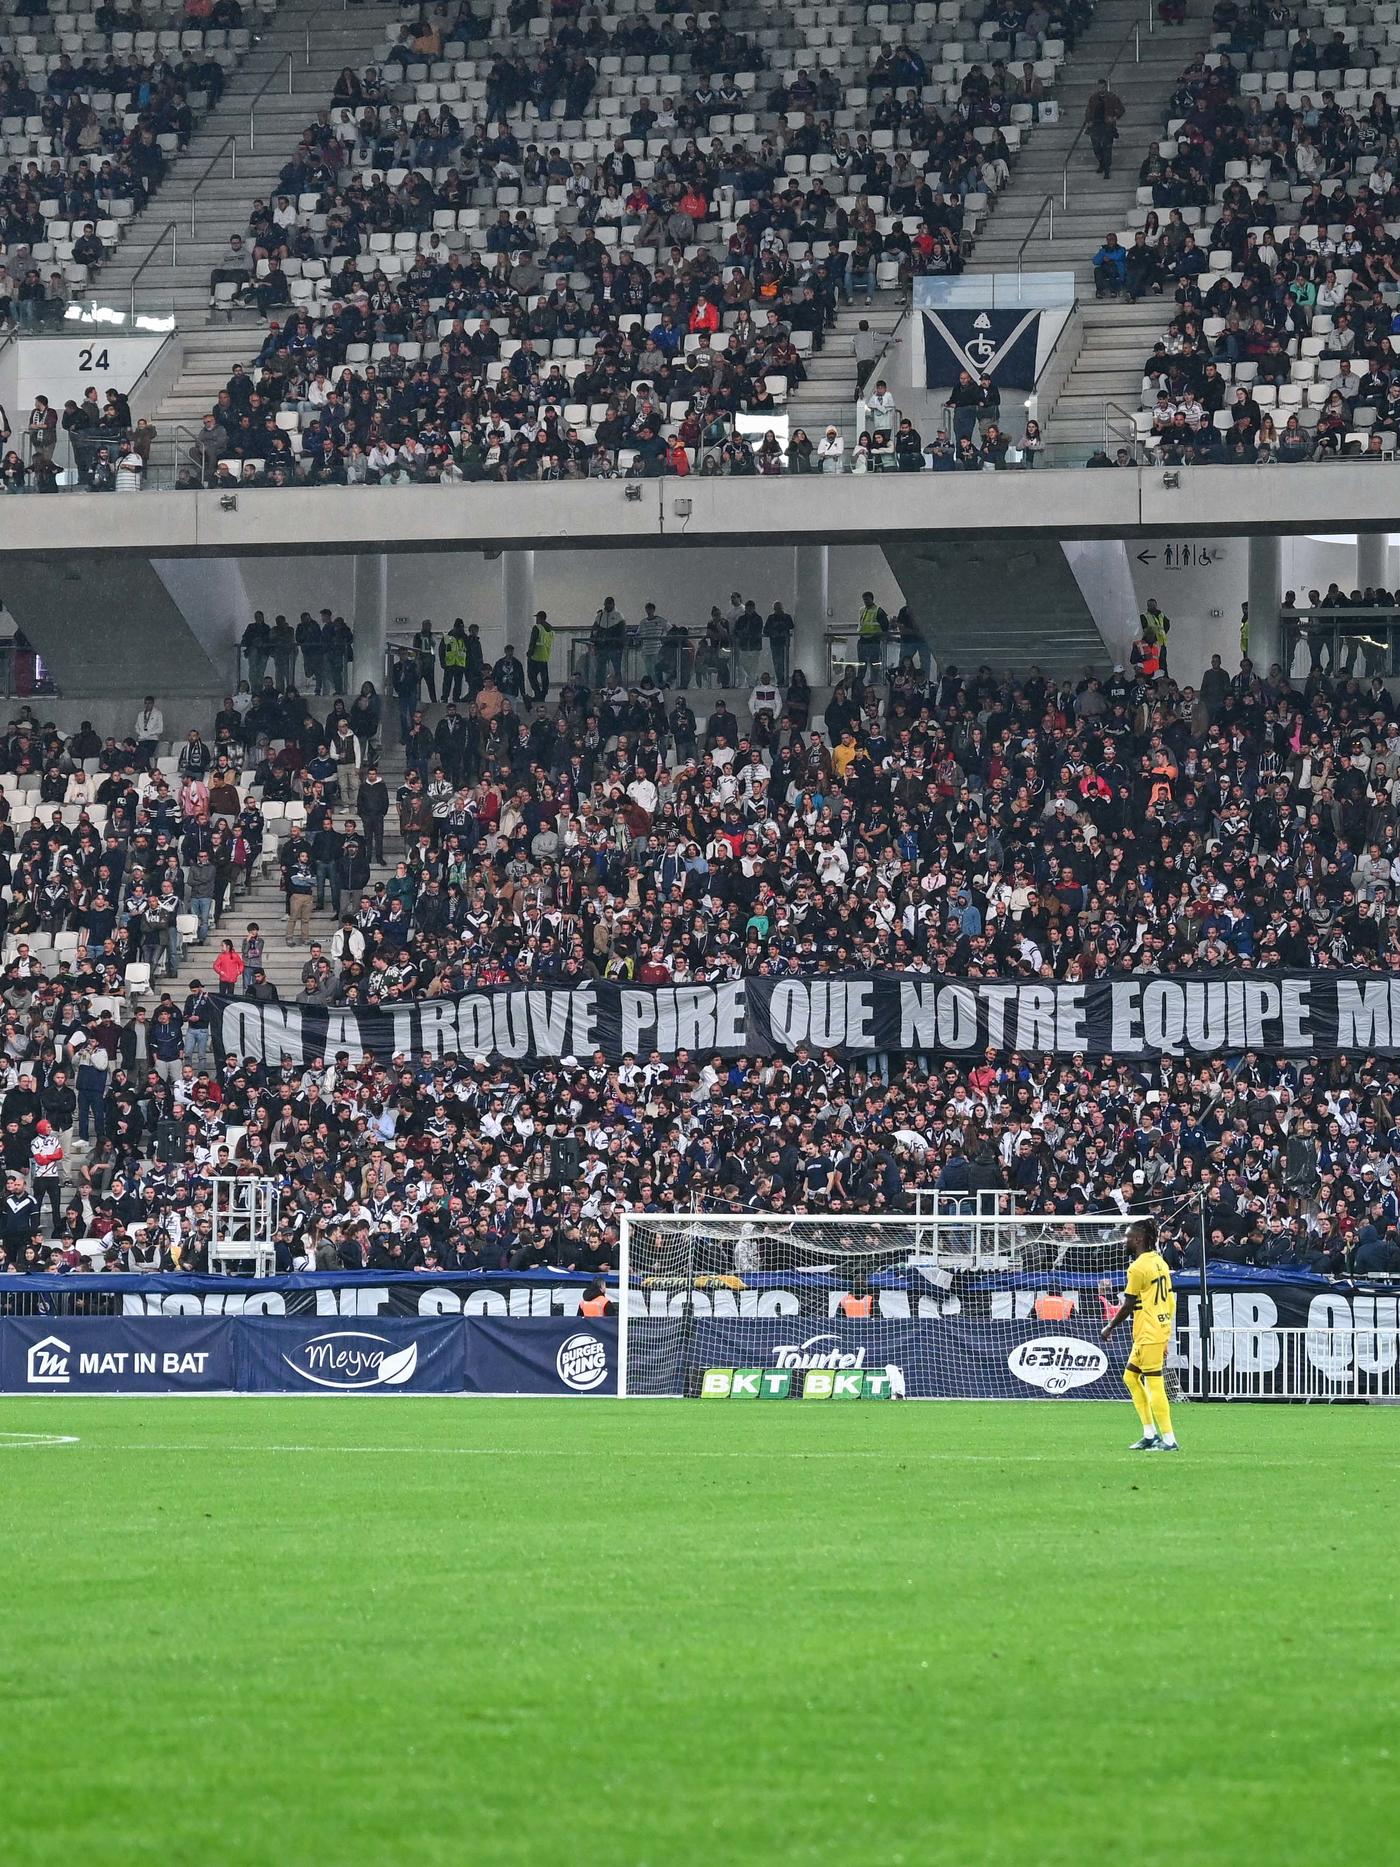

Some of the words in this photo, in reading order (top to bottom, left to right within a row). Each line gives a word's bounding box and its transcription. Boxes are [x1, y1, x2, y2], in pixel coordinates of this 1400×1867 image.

[79, 349, 110, 371] 24
[221, 1002, 304, 1067] ON
[324, 1006, 364, 1065] A
[379, 979, 601, 1062] TROUVÉ
[620, 980, 748, 1056] PIRE
[769, 980, 875, 1052] QUE
[900, 980, 1089, 1051] NOTRE
[1111, 979, 1314, 1056] EQUIPE
[1150, 1275, 1168, 1305] 70
[1163, 1292, 1280, 1374] LUB
[79, 1352, 129, 1374] MAT
[134, 1352, 156, 1374] IN
[162, 1352, 209, 1374] BAT
[304, 1343, 385, 1377] Meyva
[562, 1342, 604, 1365] BURGER
[771, 1346, 866, 1369] Tourtel
[563, 1352, 606, 1379] KING
[703, 1374, 789, 1394] BKT
[806, 1375, 890, 1394] BKT
